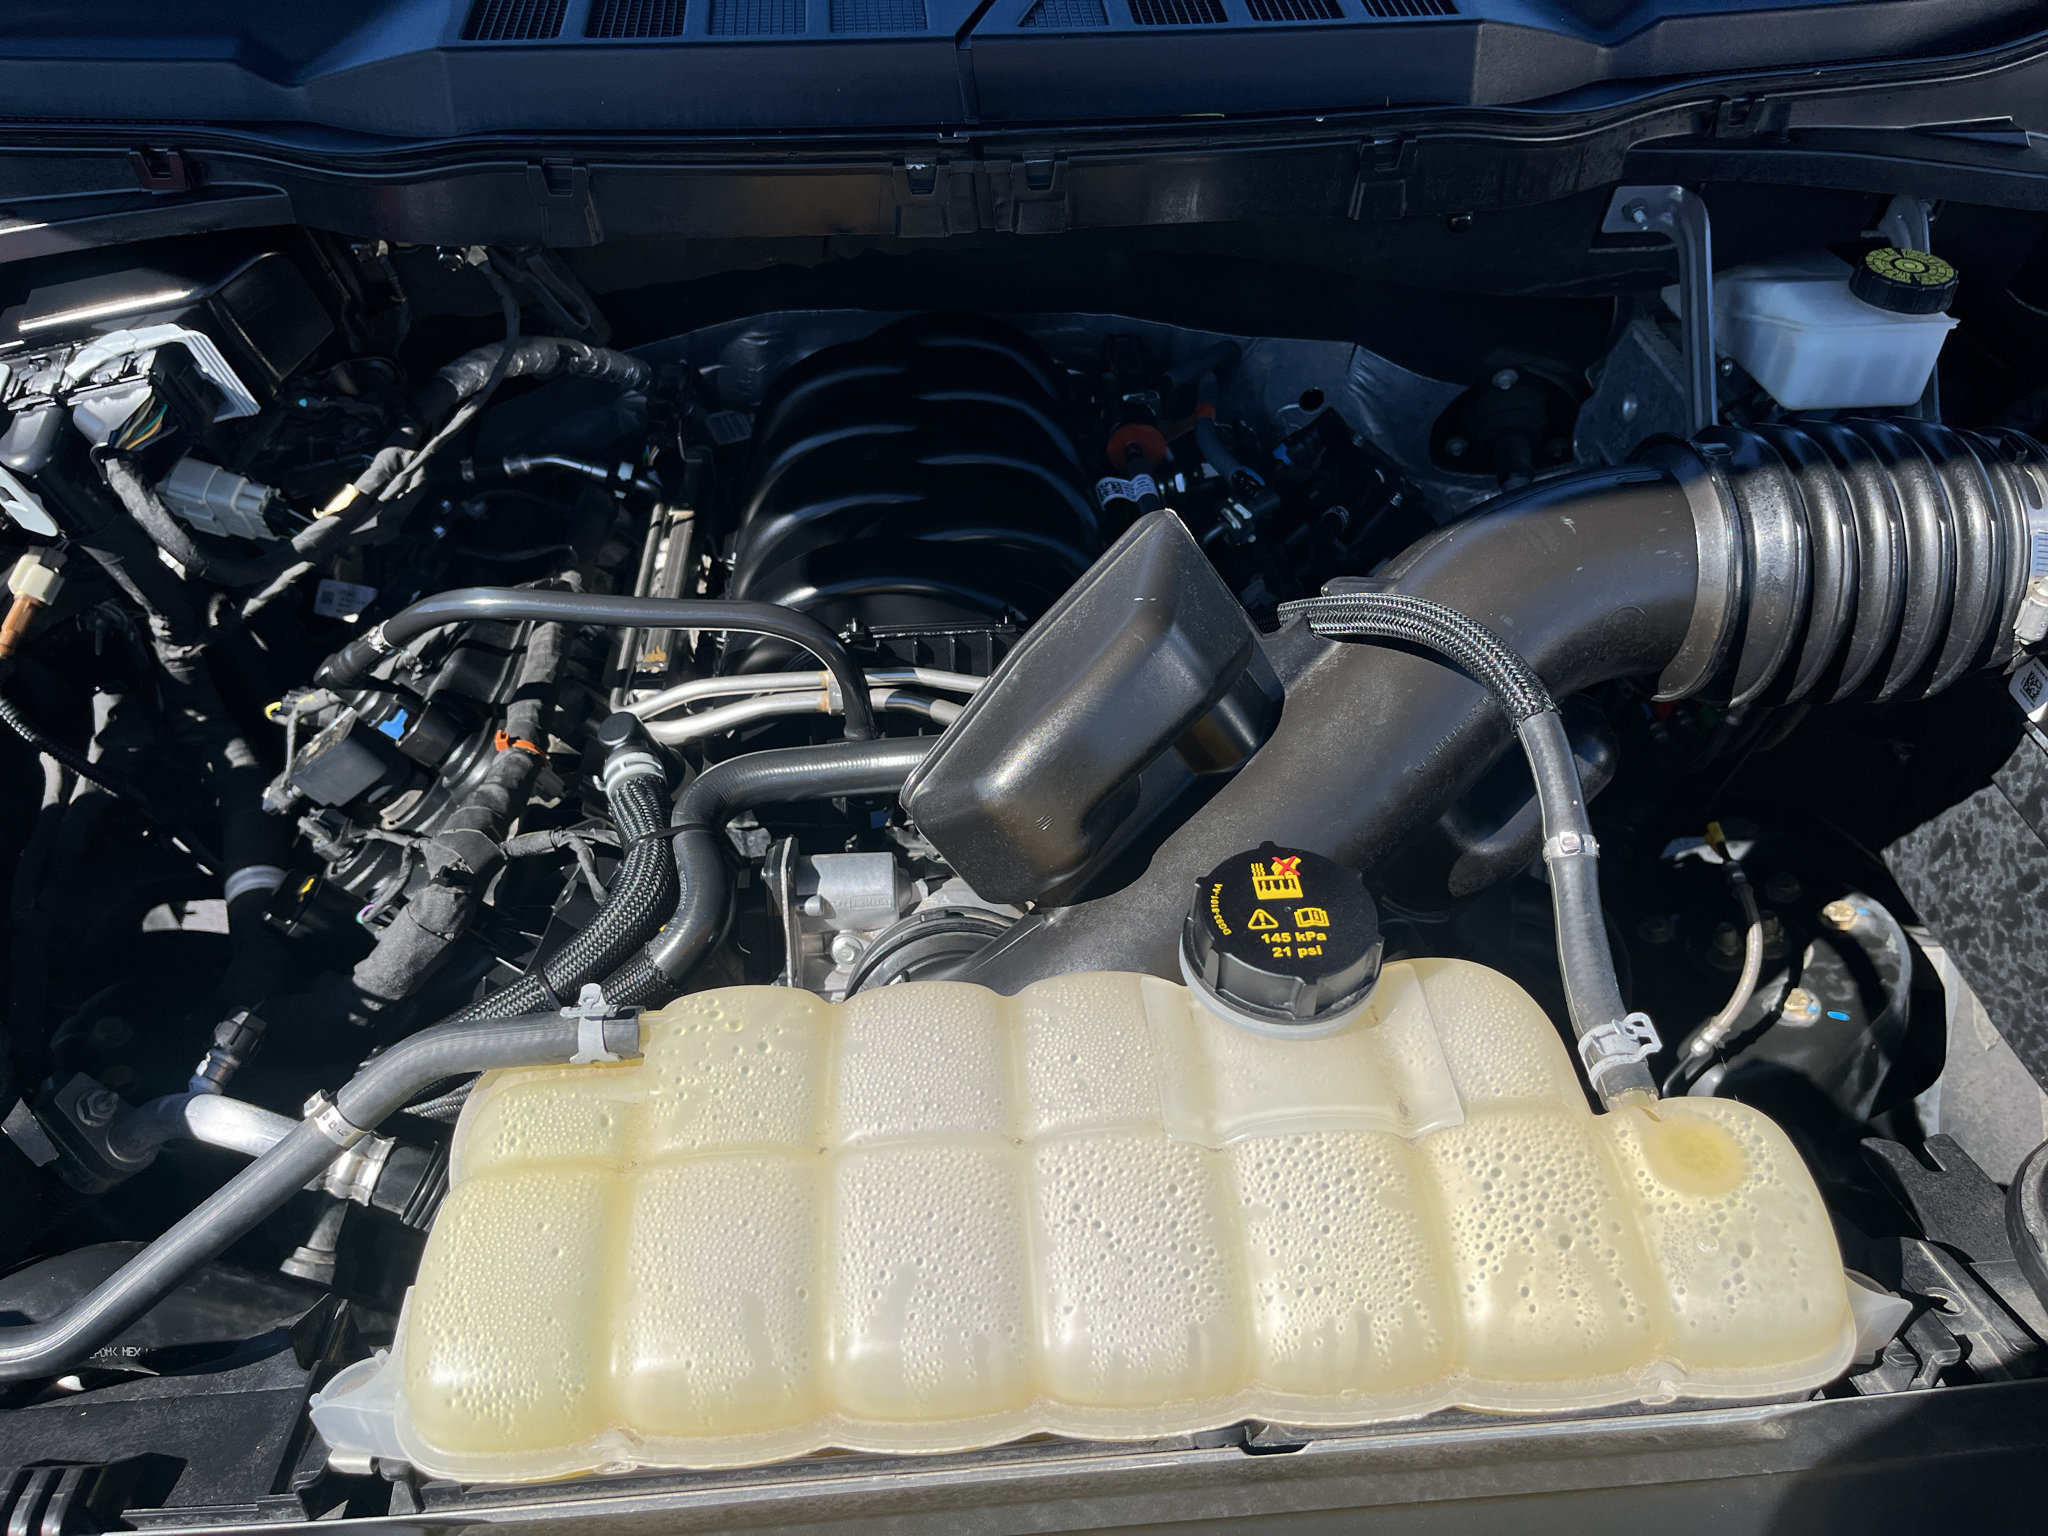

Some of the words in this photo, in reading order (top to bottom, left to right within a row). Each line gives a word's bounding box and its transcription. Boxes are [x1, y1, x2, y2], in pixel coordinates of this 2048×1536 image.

[1210, 883, 1232, 936] DG93-8101-AA
[1261, 932, 1292, 944] 145
[1295, 931, 1328, 942] kPa
[1272, 946, 1292, 958] 21
[1297, 944, 1323, 959] psi
[121, 1346, 141, 1357] MEX
